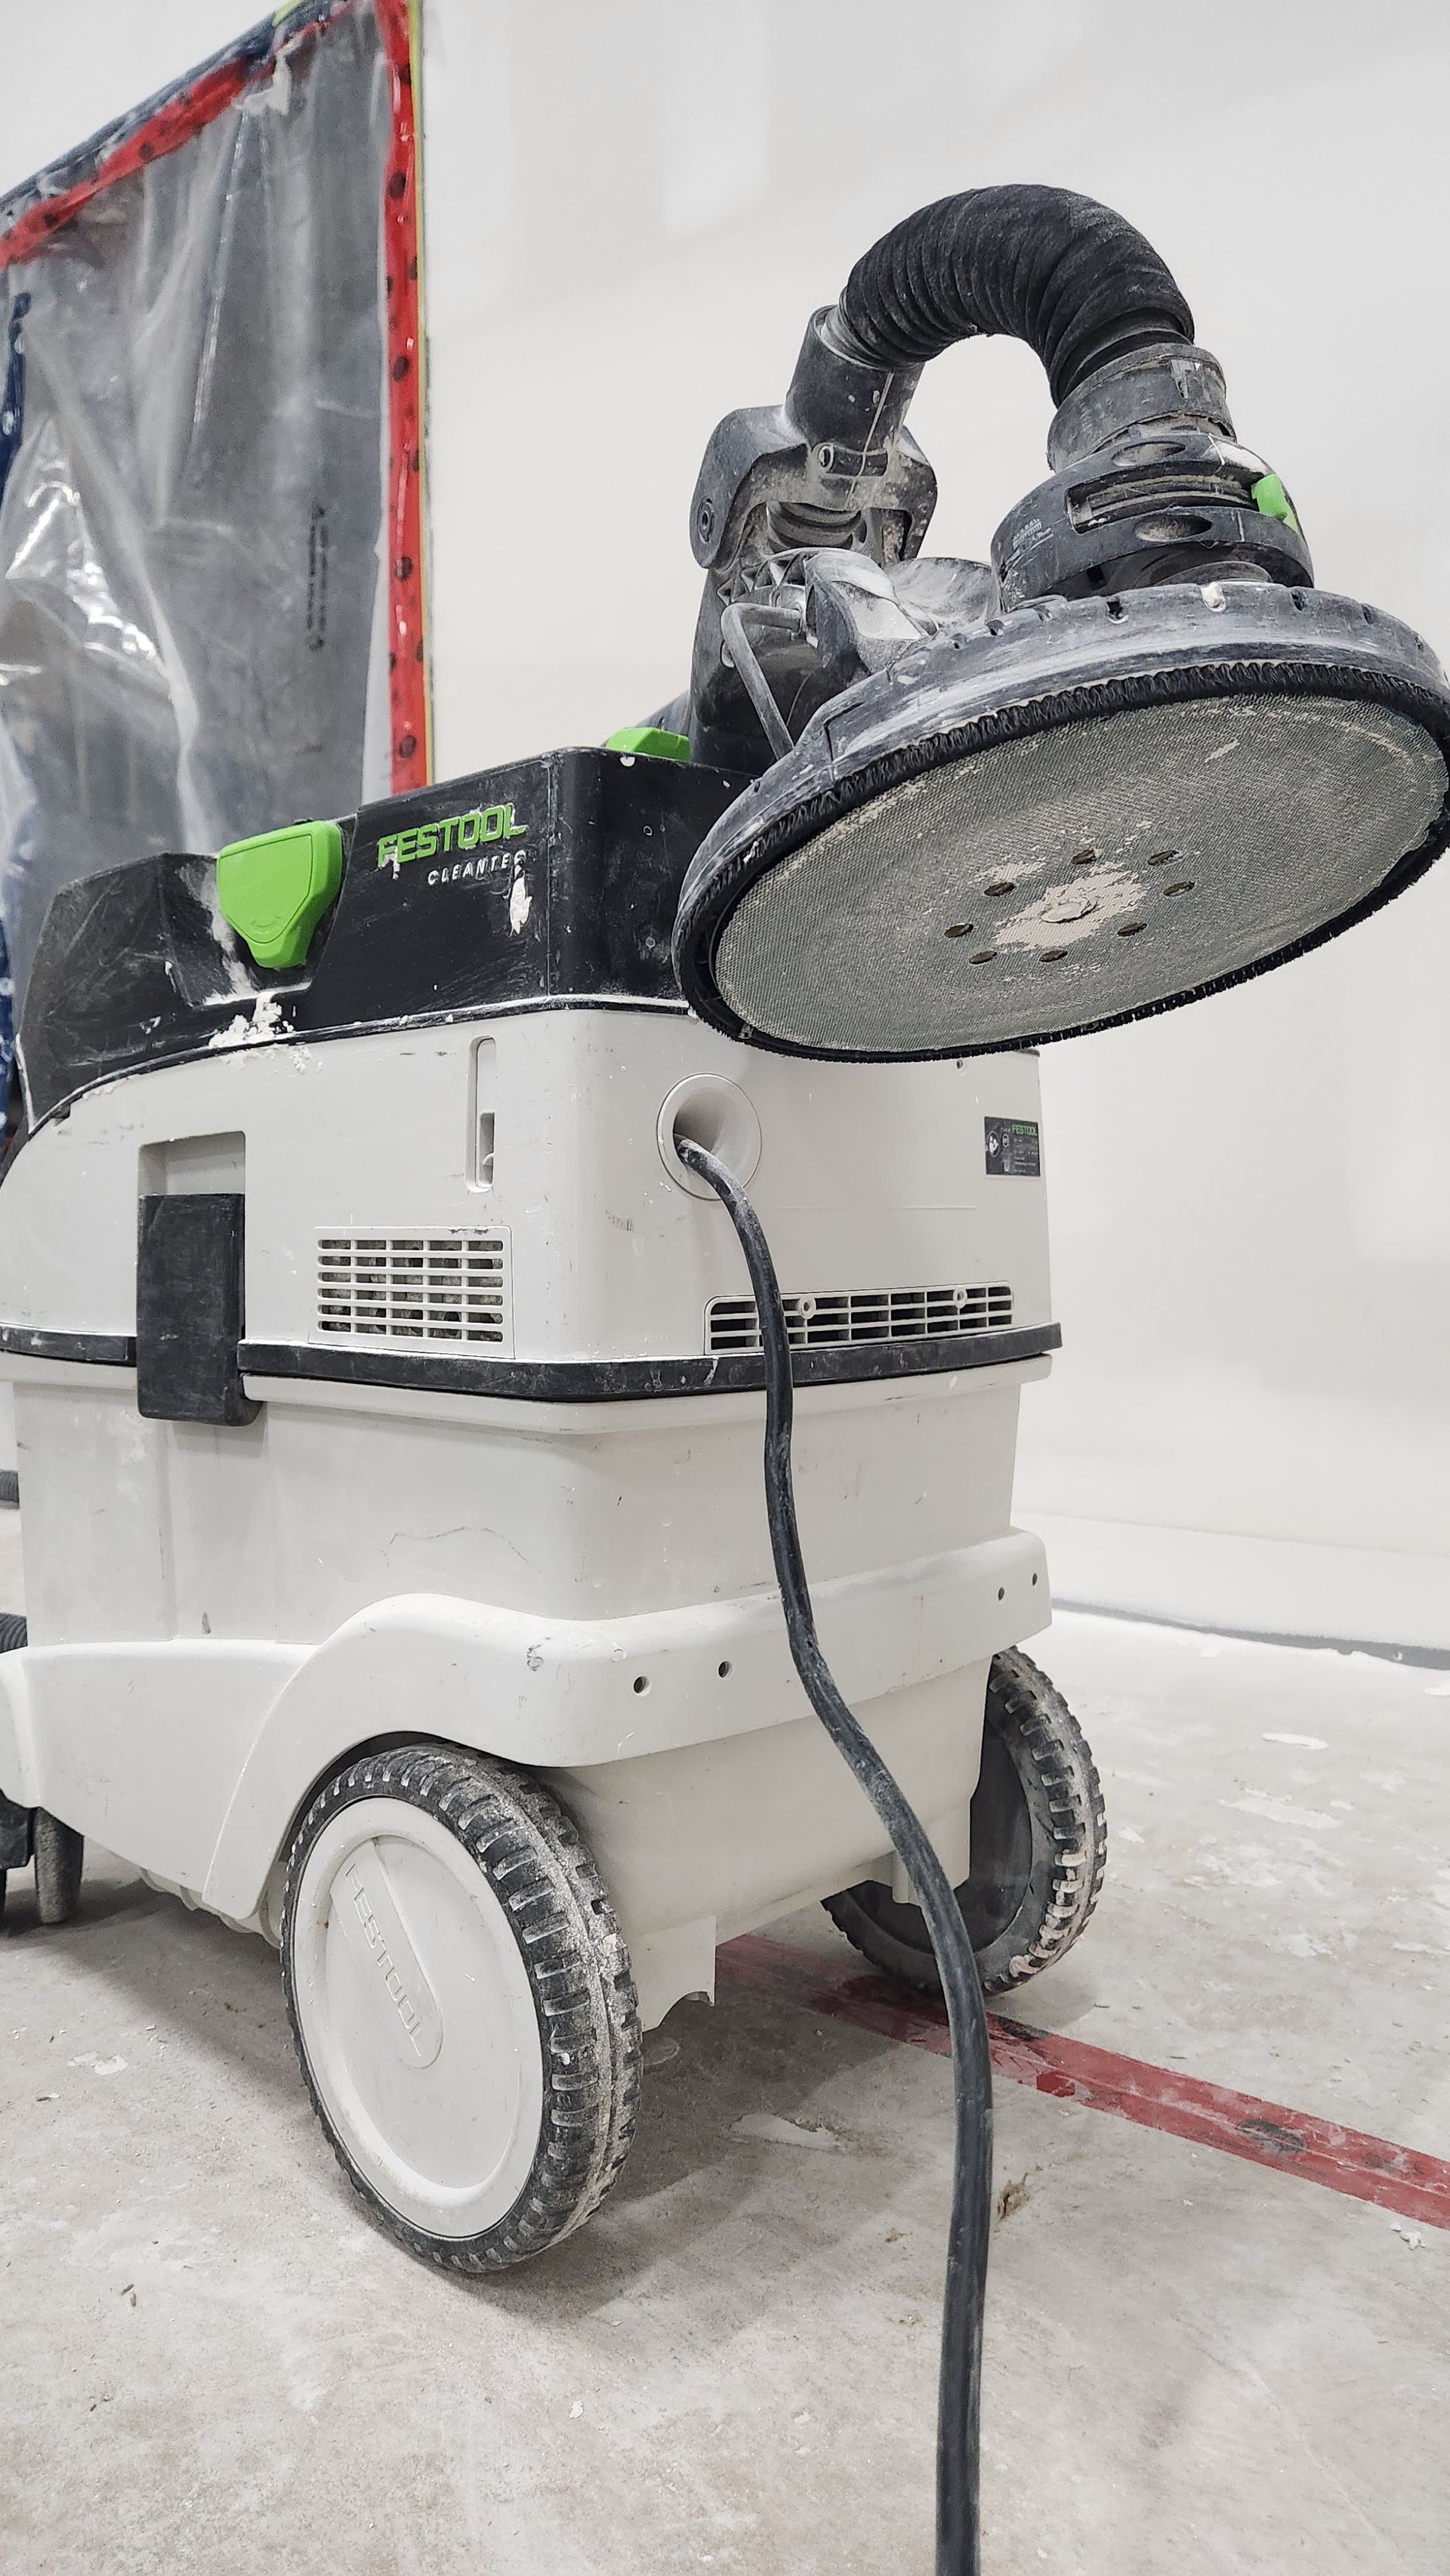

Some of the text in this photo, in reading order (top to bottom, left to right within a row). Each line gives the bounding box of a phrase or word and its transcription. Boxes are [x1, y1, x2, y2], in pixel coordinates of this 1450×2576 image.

[377, 802, 529, 866] FESTOOL
[1011, 1124, 1038, 1137] FESTOOL
[344, 1863, 423, 2057] FESTOOL
